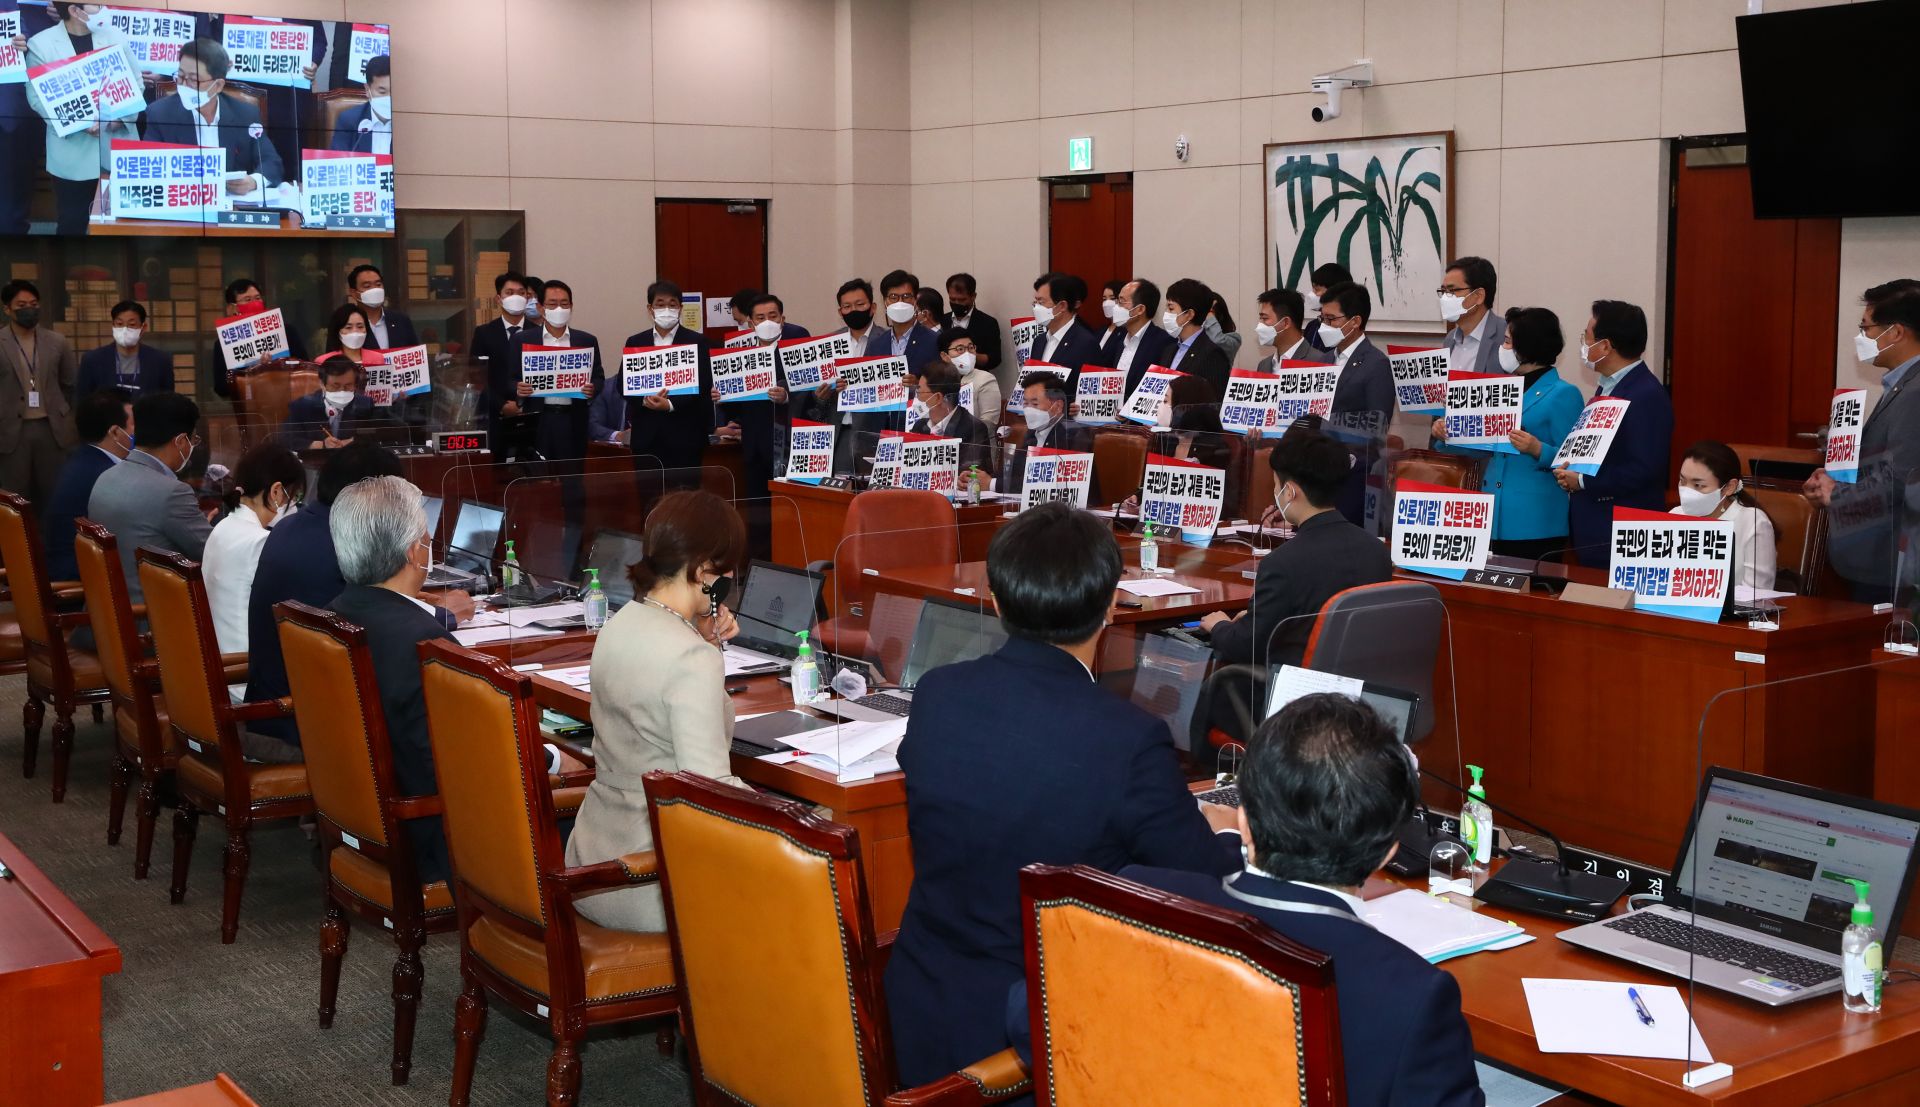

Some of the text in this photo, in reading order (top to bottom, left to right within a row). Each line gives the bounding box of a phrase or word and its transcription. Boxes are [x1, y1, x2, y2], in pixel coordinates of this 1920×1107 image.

[132, 16, 150, 36] 눈과
[153, 18, 171, 37] 귀를
[173, 20, 191, 39] 막는
[227, 29, 309, 51] 언론재갈! 언론탄압!
[234, 54, 300, 74] 무엇이 두려운가!
[39, 68, 86, 102] 언론말살!
[54, 95, 94, 127] 민주당은
[116, 155, 221, 179] 언론말살! 언론장악!
[307, 164, 352, 187] 언론말살!
[120, 183, 217, 208] 민주당은 중단하라!
[311, 192, 350, 216] 민주당은
[221, 313, 282, 345] 언론재갈! 언론탄압!
[233, 333, 282, 362] 무엇이 두려운가!
[782, 338, 850, 367] 국민의 눈과 귀를 막는
[393, 349, 425, 370] 언론탄압!
[524, 352, 592, 371] 언론말살! 언론장악!
[626, 349, 695, 372] 국민의 눈과 귀를 막는
[713, 351, 772, 376] 국민의 눈과 귀를 막는
[1392, 355, 1448, 381] 국민의 눈과 귀를 막는
[379, 370, 391, 385] 막는
[556, 372, 590, 389] 중단하라!
[627, 368, 696, 391] 언론재갈법 철회하라!
[714, 371, 774, 395] 언론재갈법 철회하라!
[787, 366, 820, 387] 언론재갈법
[861, 365, 876, 383] 눈과
[876, 363, 890, 381] 귀를
[891, 360, 906, 378] 막는
[1280, 371, 1337, 394] 국민의 눈과 귀를 막는
[841, 382, 906, 406] 언론재갈법 철회하라!
[1078, 376, 1124, 395] 언론재갈! 언론탄압!
[1138, 376, 1169, 395] 언론재갈!
[1228, 383, 1255, 401] 국민의
[1254, 384, 1271, 403] 눈과
[1397, 384, 1426, 405] 언론재갈법
[1447, 383, 1520, 409] 국민의 눈과 귀를 막는
[1080, 399, 1095, 417] 무엇이
[1132, 397, 1153, 415] 무엇이
[1222, 405, 1265, 426] 언론재갈법
[1278, 399, 1309, 420] 언론재갈법
[1586, 406, 1623, 429] 언론탄압!
[1845, 399, 1861, 426] 막는
[1446, 413, 1517, 438] 언론재갈법 철회하라!
[466, 438, 479, 448] 35
[792, 430, 833, 450] 언론말살! 언론장악!
[1571, 434, 1603, 458] 두려운가!
[790, 454, 830, 473] 민주당은 중단하라!
[876, 442, 898, 462] 언론말살!
[903, 447, 920, 467] 국민의
[920, 446, 932, 466] 눈과
[933, 446, 944, 465] 귀를
[945, 445, 956, 464] 막는
[930, 470, 956, 491] 철회하라!
[1026, 459, 1089, 483] 언론재갈! 언론탄압!
[1146, 471, 1221, 500] 국민의 눈과 귀를 막는
[1143, 499, 1218, 529] 언론재갈법 철회하라!
[1397, 498, 1442, 527] 언론재갈!
[1443, 500, 1489, 529] 언론탄압!
[1402, 532, 1477, 562] 무엇이 두려운가!
[1616, 528, 1727, 560] 국민의 눈과 귀를 막는
[1614, 565, 1724, 599] 언론재갈법 철회하라!
[1732, 816, 1754, 826] NAVER
[1759, 922, 1782, 933] SAMSUNG
